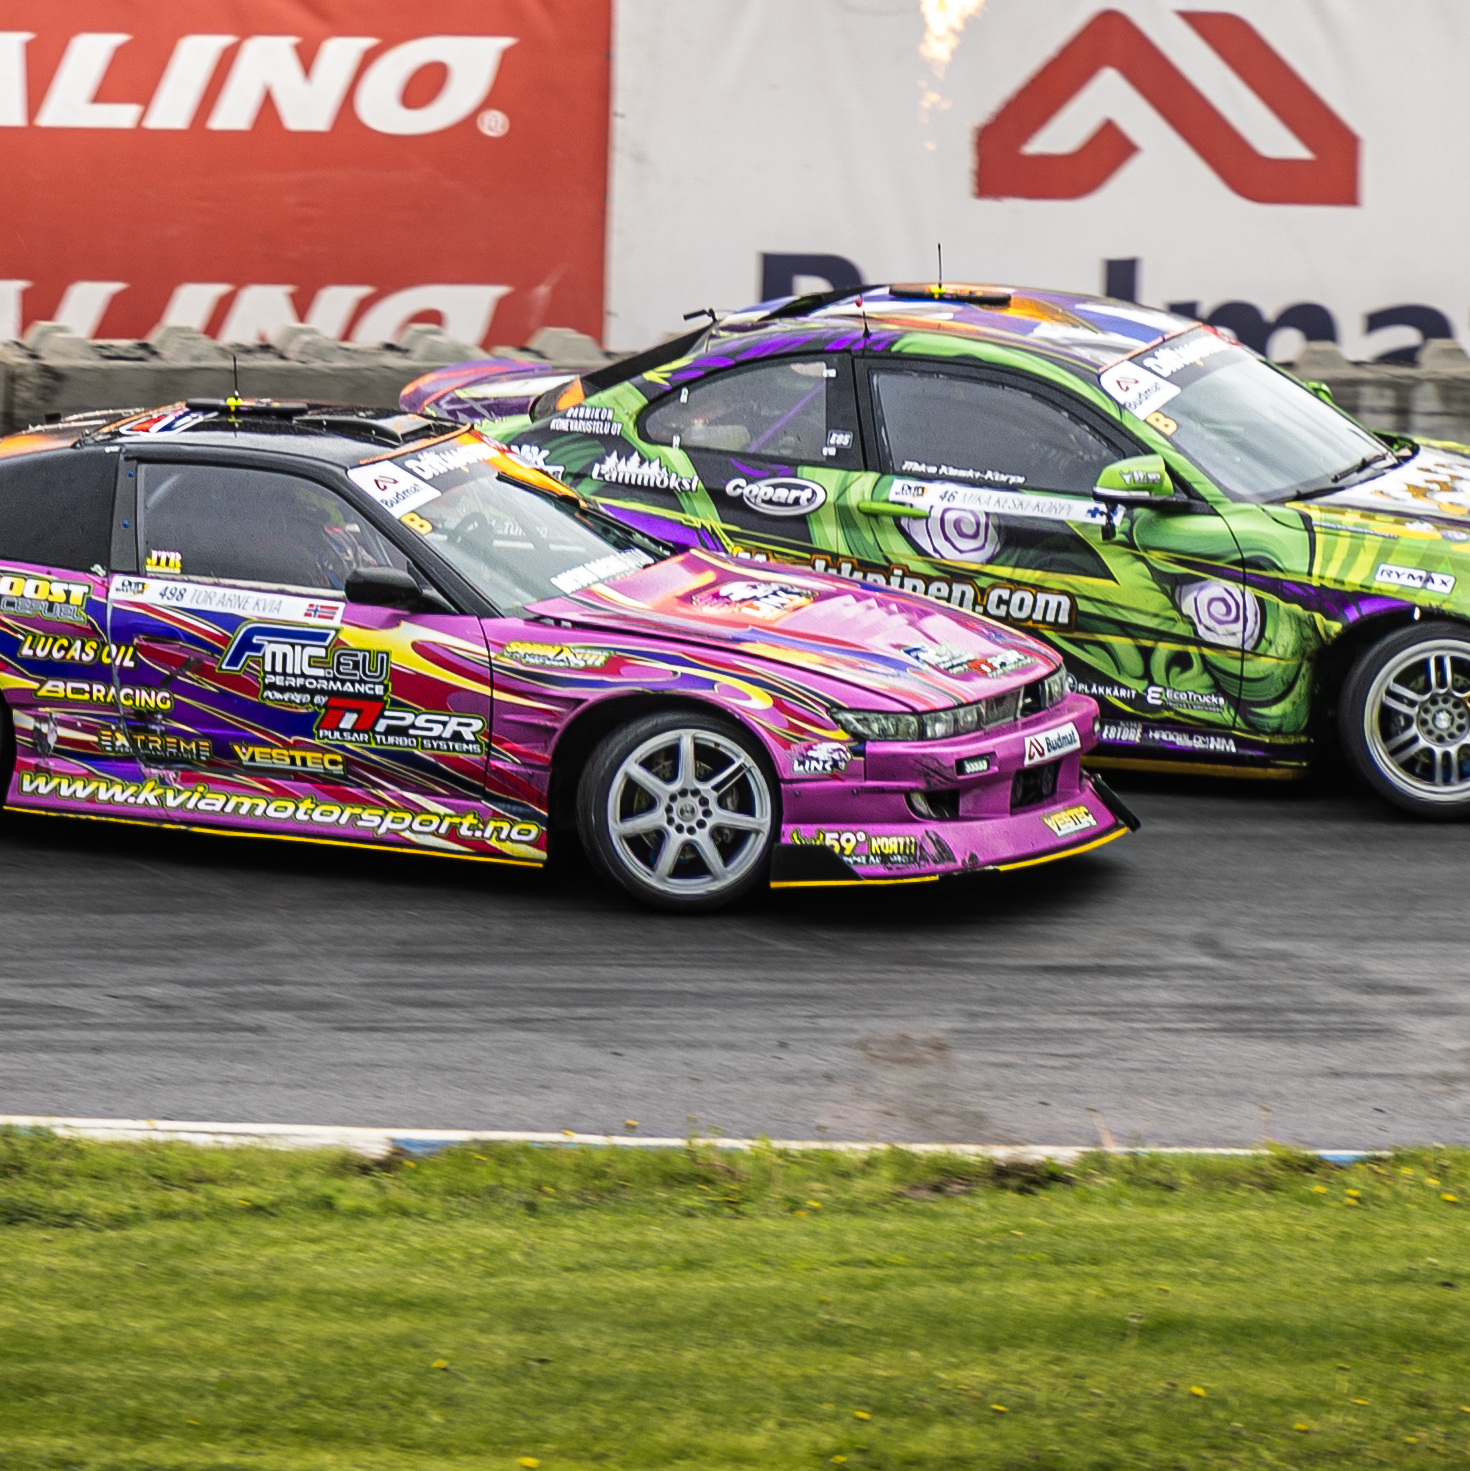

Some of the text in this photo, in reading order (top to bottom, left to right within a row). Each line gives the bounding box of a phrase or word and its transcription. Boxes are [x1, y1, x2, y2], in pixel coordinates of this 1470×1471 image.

[1145, 411, 1178, 437] B
[725, 478, 818, 508] Copart
[938, 490, 959, 503] 46
[399, 512, 434, 536] B
[1379, 567, 1452, 589] RYMAX
[158, 585, 188, 602] 498
[218, 592, 251, 610] ARNE
[21, 635, 137, 668] LUCAS OIL
[264, 674, 385, 696] PERFORMANCE
[1165, 687, 1225, 706] EcoTrucks
[262, 690, 329, 706] POWERED BY
[374, 710, 485, 741] PSR
[100, 730, 211, 761] EXTREME
[319, 729, 482, 754] PULSAR TURBO SYSTEMS
[1045, 727, 1078, 754] Budmat
[232, 744, 344, 772] VESTEC
[20, 773, 540, 842] www.kviamotorsport.no
